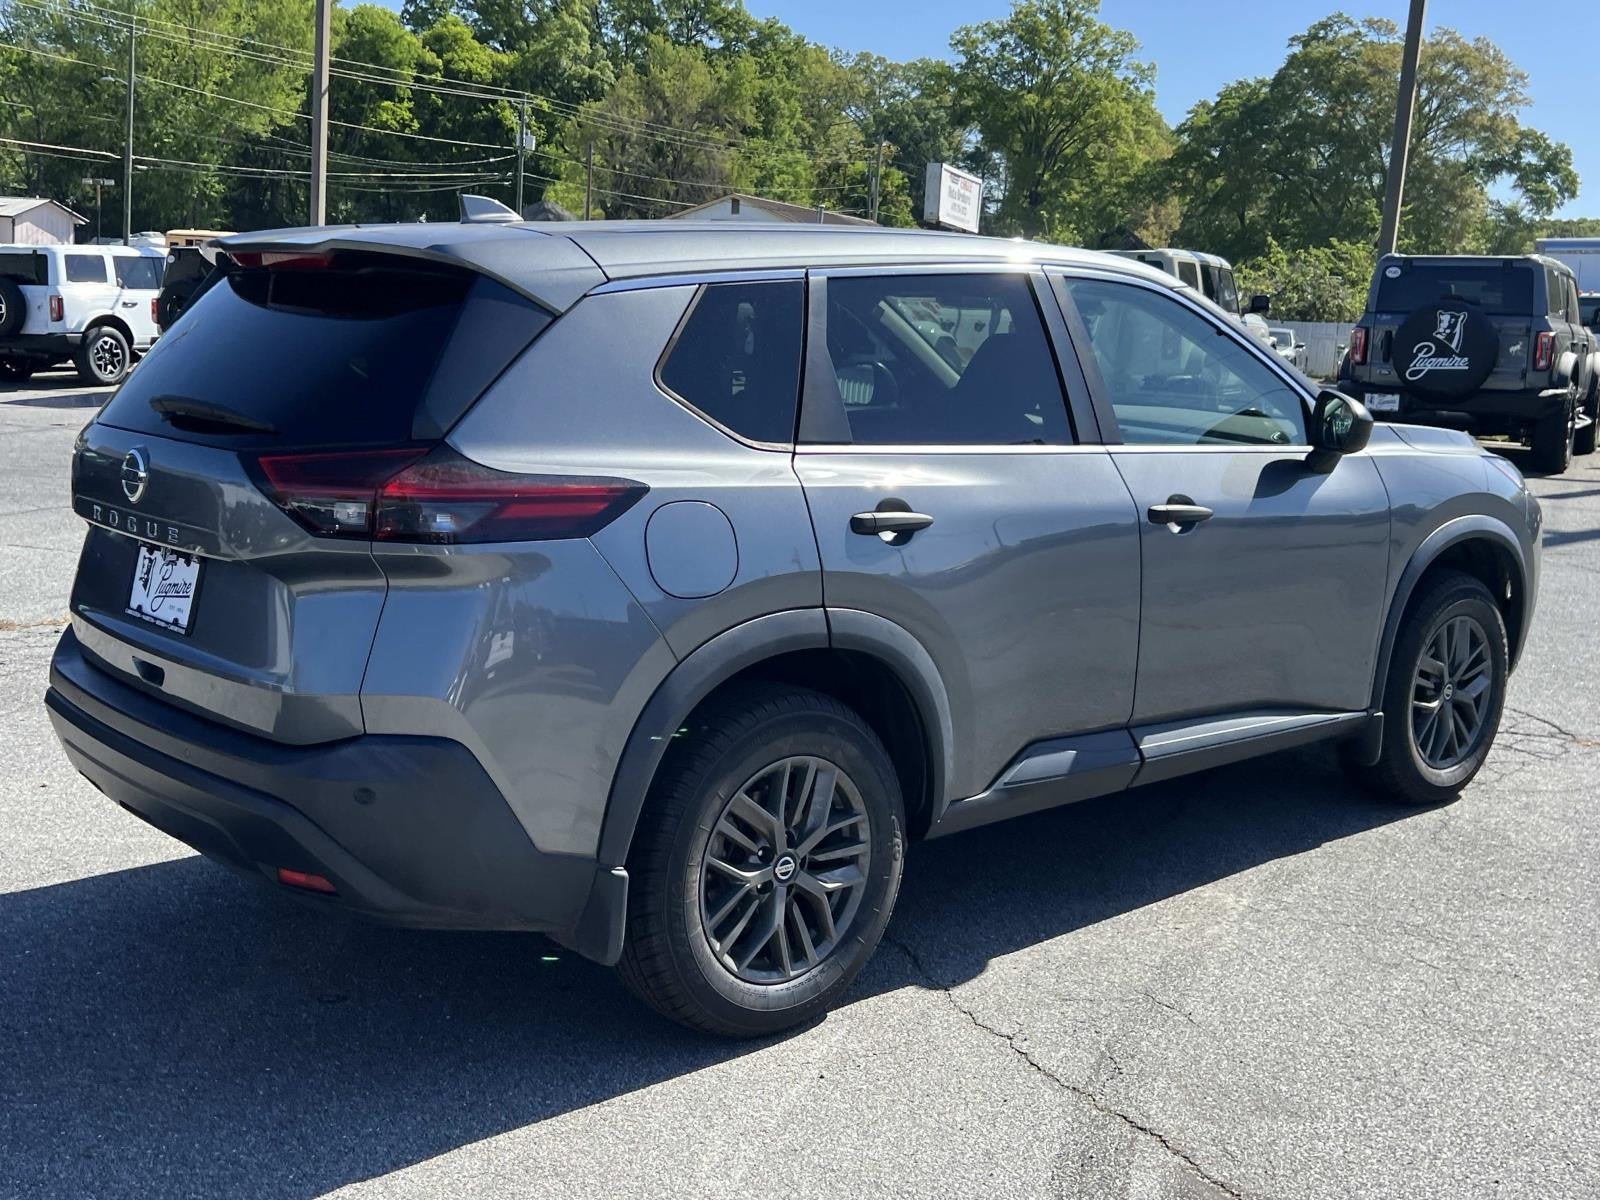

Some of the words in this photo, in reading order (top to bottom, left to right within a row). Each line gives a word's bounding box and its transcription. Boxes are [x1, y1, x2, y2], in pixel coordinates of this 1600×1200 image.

[1405, 341, 1470, 381] Pugmire
[93, 504, 179, 544] ROGUE
[151, 563, 192, 612] Pugmire
